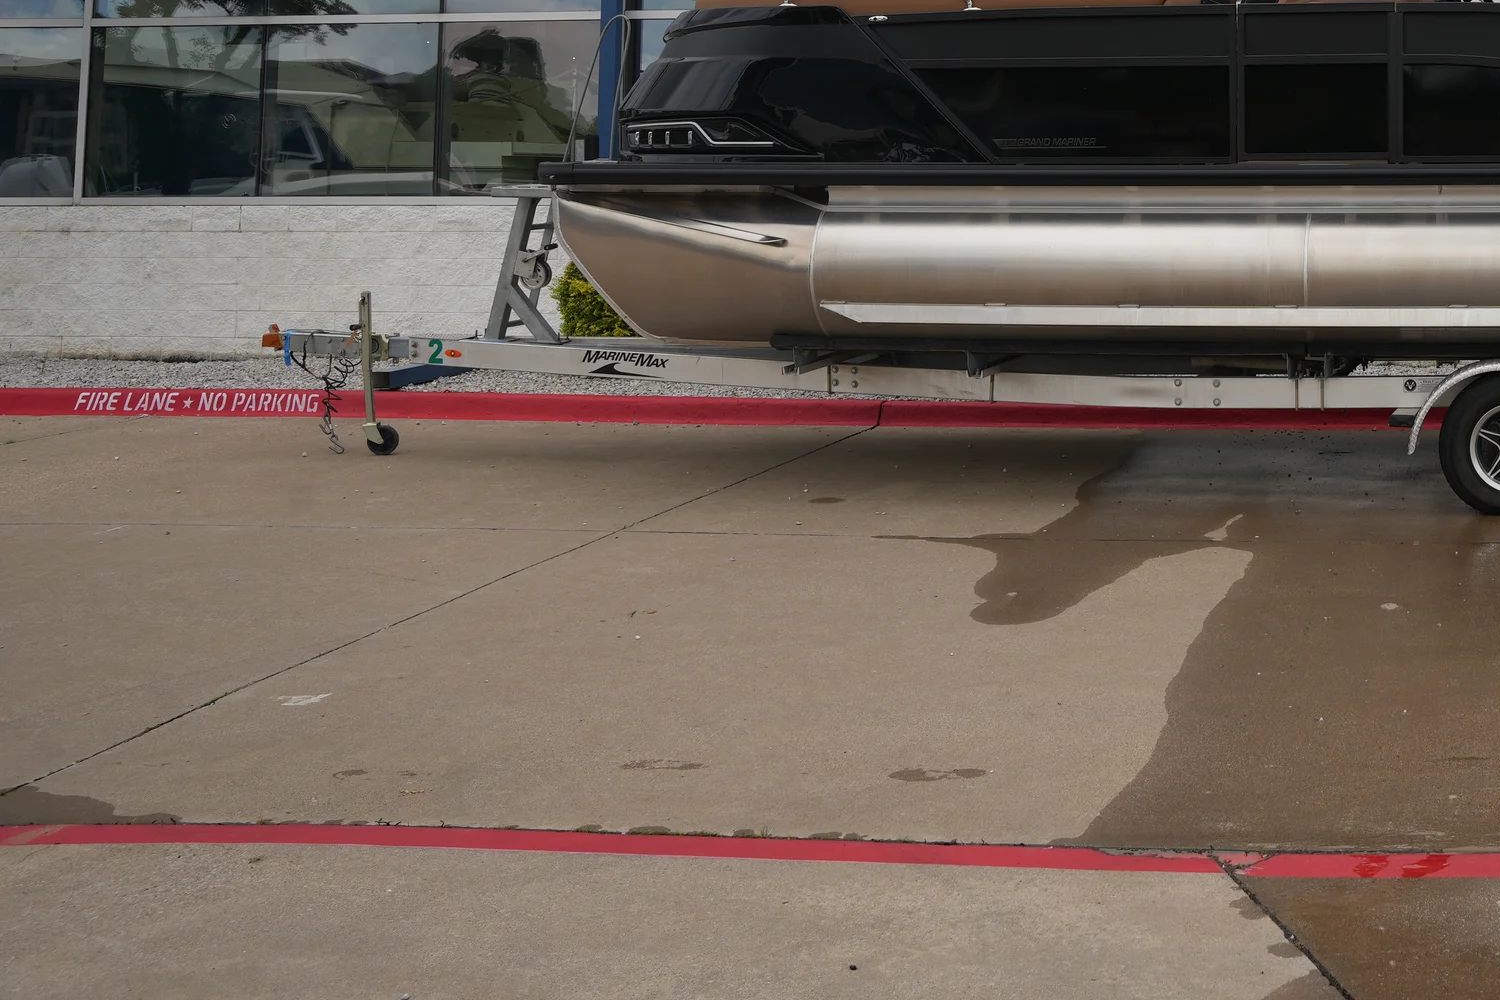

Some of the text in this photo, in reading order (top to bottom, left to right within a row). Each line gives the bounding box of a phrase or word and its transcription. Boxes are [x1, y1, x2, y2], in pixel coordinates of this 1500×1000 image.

[1016, 137, 1051, 147] GRAND
[1052, 137, 1098, 147] MARINER
[428, 339, 444, 364] 2
[74, 392, 320, 413] FIRE LANE NO PARKING
